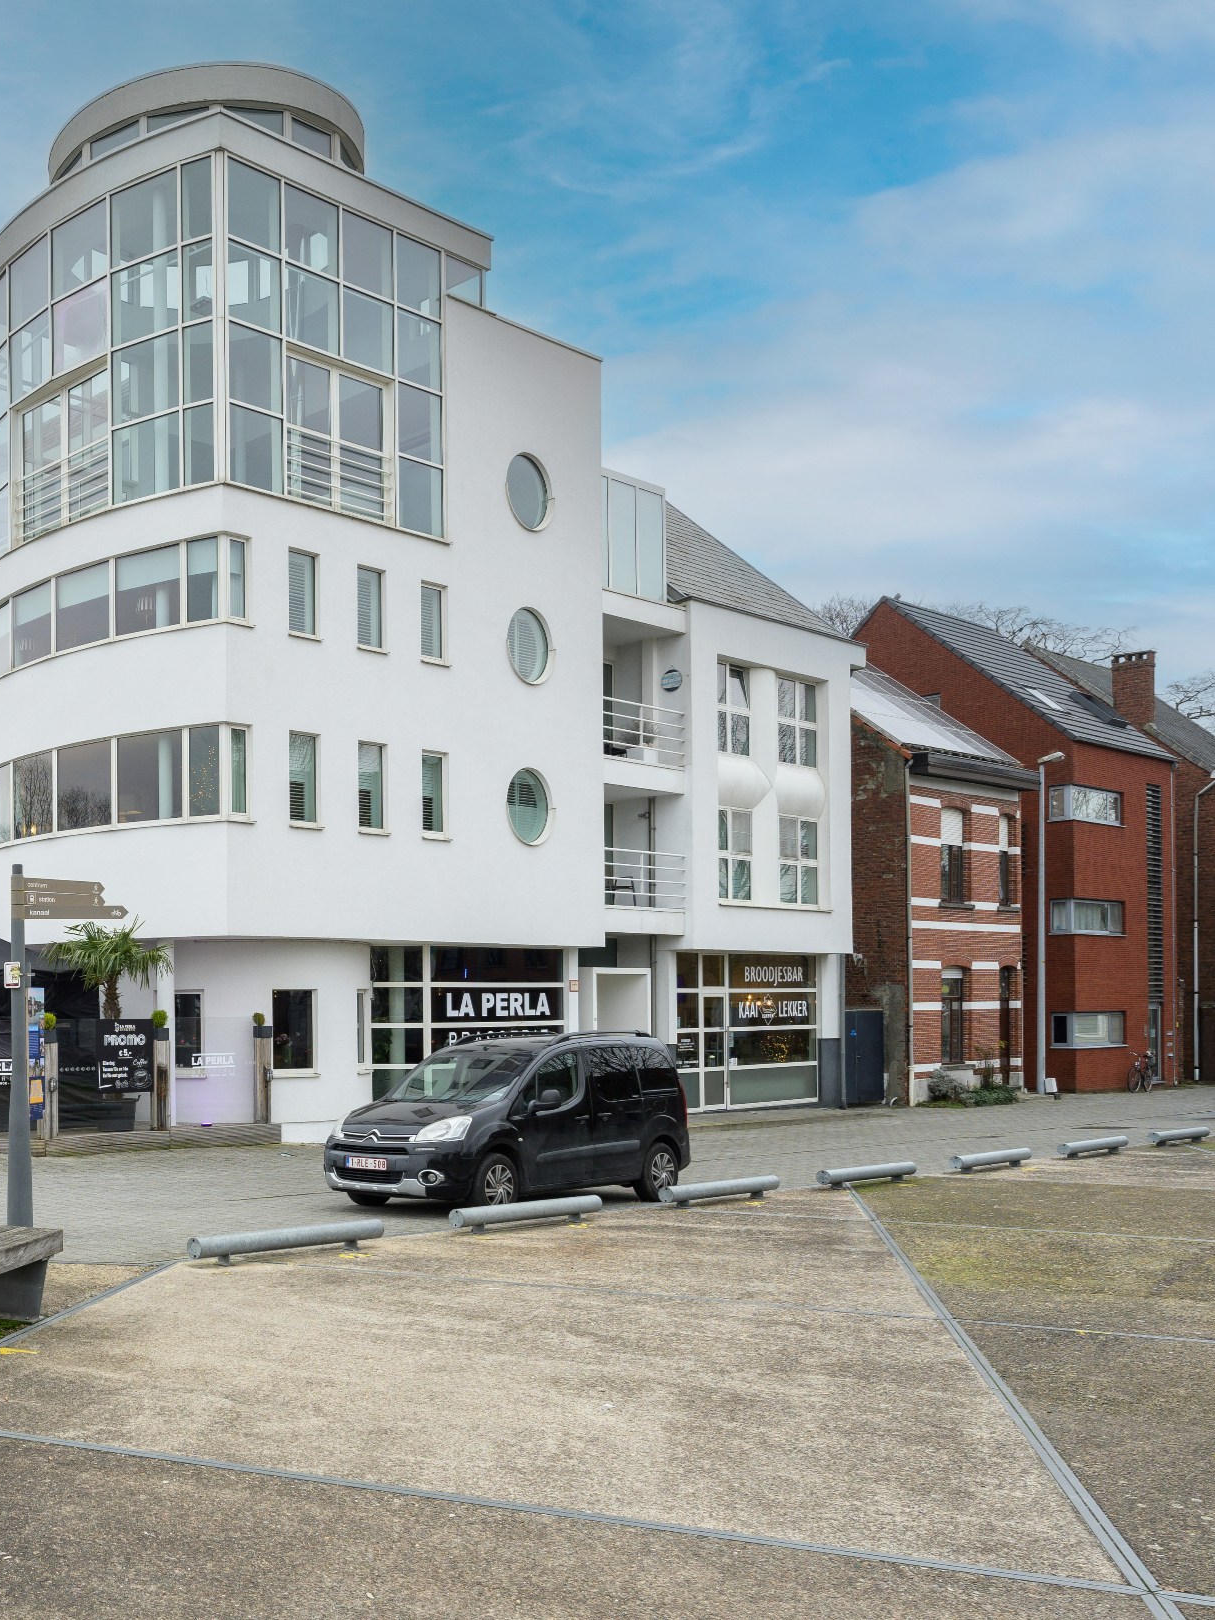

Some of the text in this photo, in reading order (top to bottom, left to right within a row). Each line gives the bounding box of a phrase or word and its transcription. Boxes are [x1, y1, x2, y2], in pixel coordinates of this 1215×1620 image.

[744, 966, 803, 987] BROODJESBAR
[446, 992, 551, 1017] LA PERLA
[738, 1000, 808, 1019] KAAI LEKKER
[103, 1033, 146, 1046] PROMO
[191, 1055, 235, 1066] LA PERLA
[351, 1157, 386, 1169] 1-RLE-508
